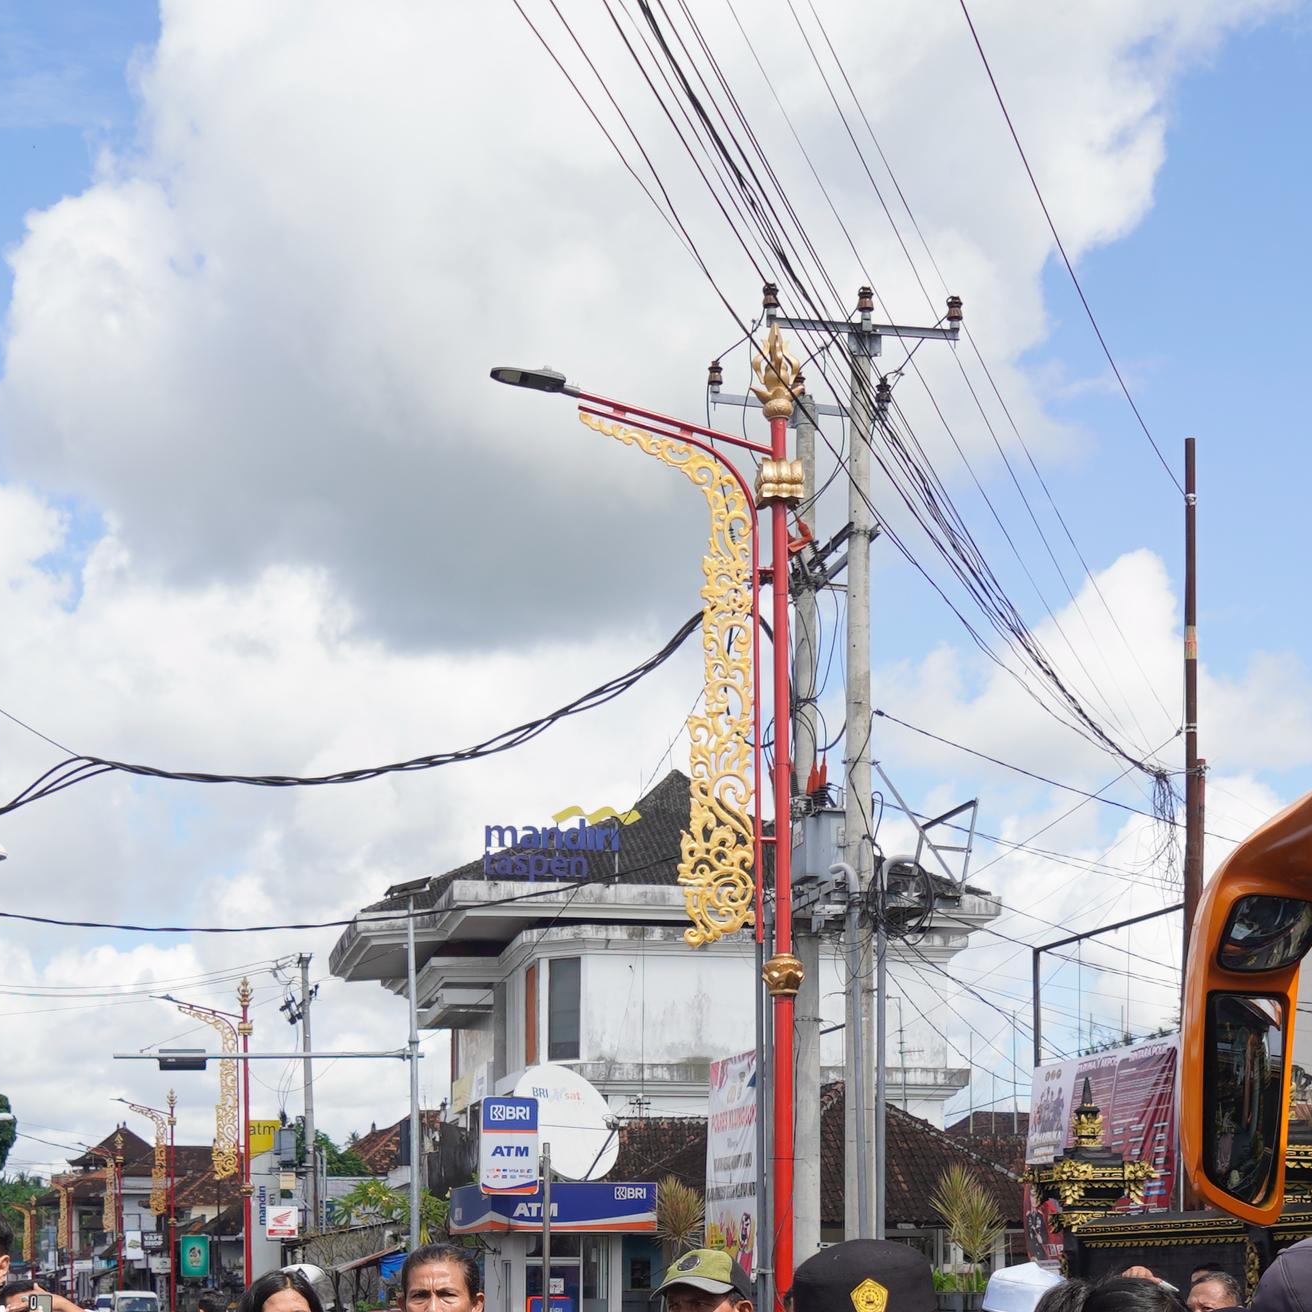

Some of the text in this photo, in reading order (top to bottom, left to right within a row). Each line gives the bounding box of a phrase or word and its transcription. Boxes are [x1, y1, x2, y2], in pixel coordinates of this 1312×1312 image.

[485, 818, 619, 851] mandiri
[483, 850, 588, 882] taspen
[532, 1086, 548, 1098] BRI
[506, 1105, 530, 1120] BRI
[249, 1125, 276, 1135] atm
[491, 1145, 529, 1157] ATM
[627, 1187, 647, 1199] BRI
[513, 1202, 558, 1217] ATM
